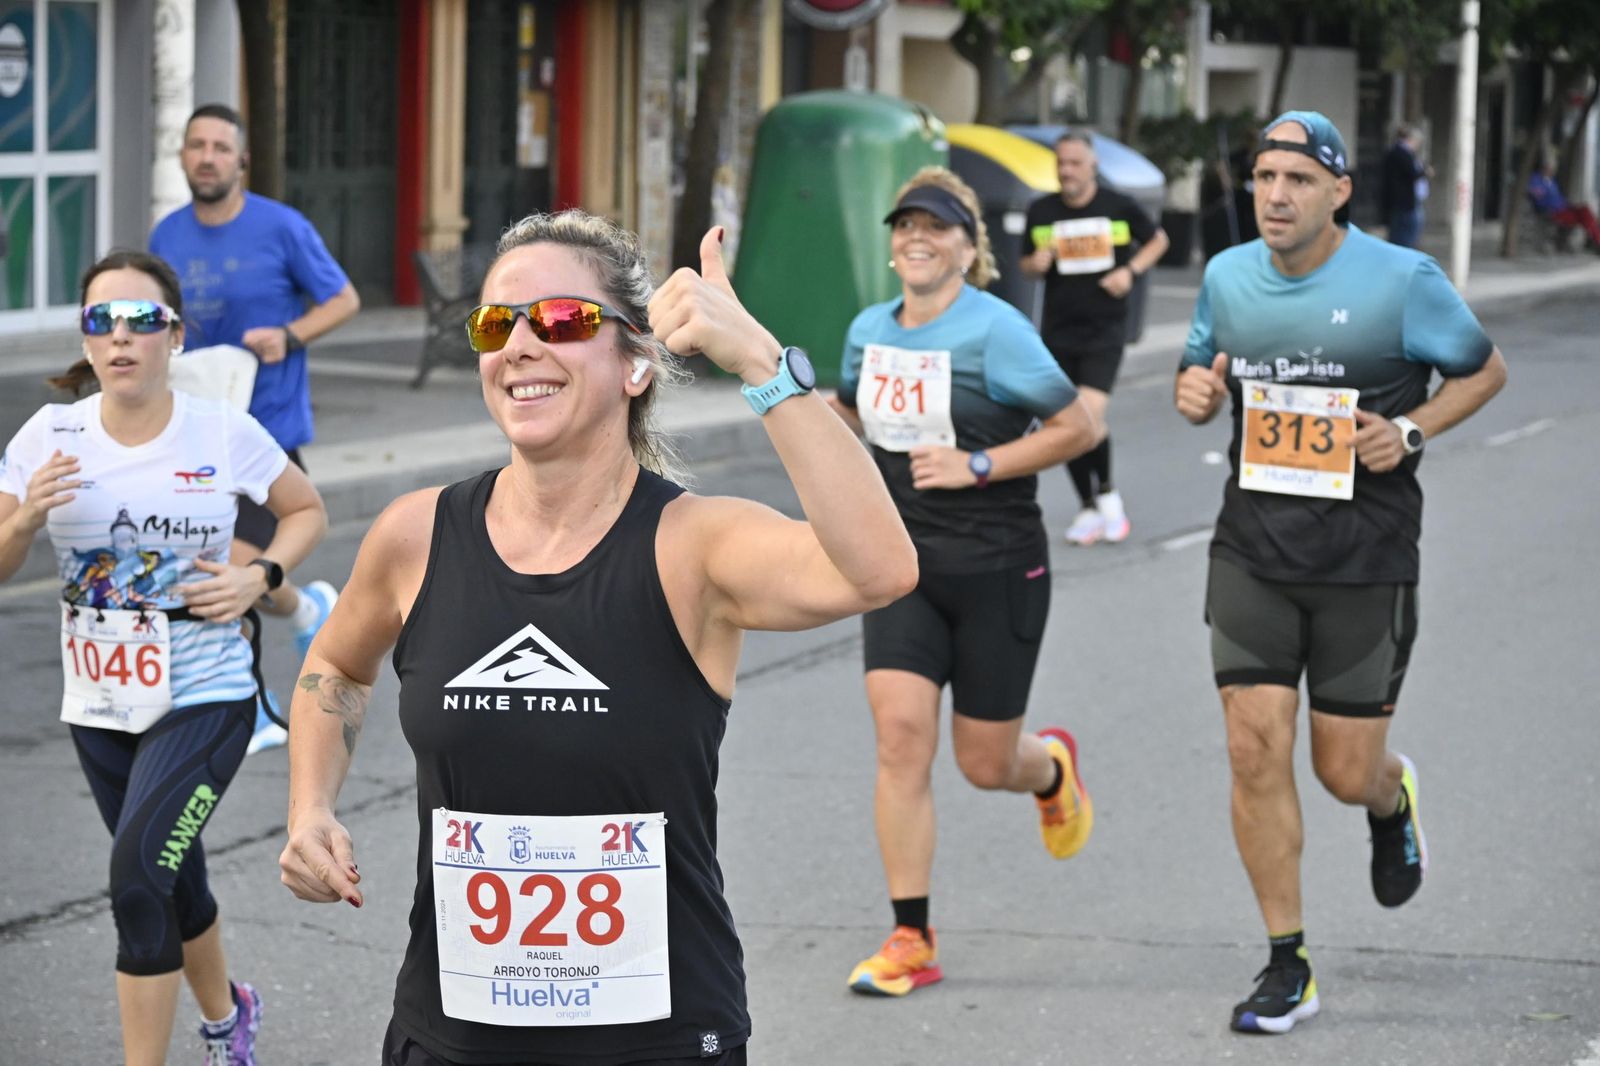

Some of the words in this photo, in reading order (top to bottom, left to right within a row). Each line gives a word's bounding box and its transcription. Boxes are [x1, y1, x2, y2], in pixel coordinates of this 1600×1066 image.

[874, 374, 924, 414] 781
[1258, 411, 1334, 454] 313
[143, 515, 221, 549] Málaga
[67, 636, 162, 687] 1046
[443, 694, 511, 711] NIKE
[523, 696, 609, 713] TRAIL
[156, 783, 219, 872] HANKER
[446, 819, 485, 854] 21K
[601, 821, 648, 853] 21K
[445, 850, 486, 866] HUELVA
[535, 851, 576, 860] HUELVA
[601, 853, 650, 867] HUELVA
[466, 871, 625, 947] 928
[526, 951, 564, 961] RAQUEL
[493, 965, 541, 977] ARROYO
[543, 965, 600, 978] TORONJO
[491, 981, 591, 1007] Huelva
[555, 1009, 591, 1020] original
